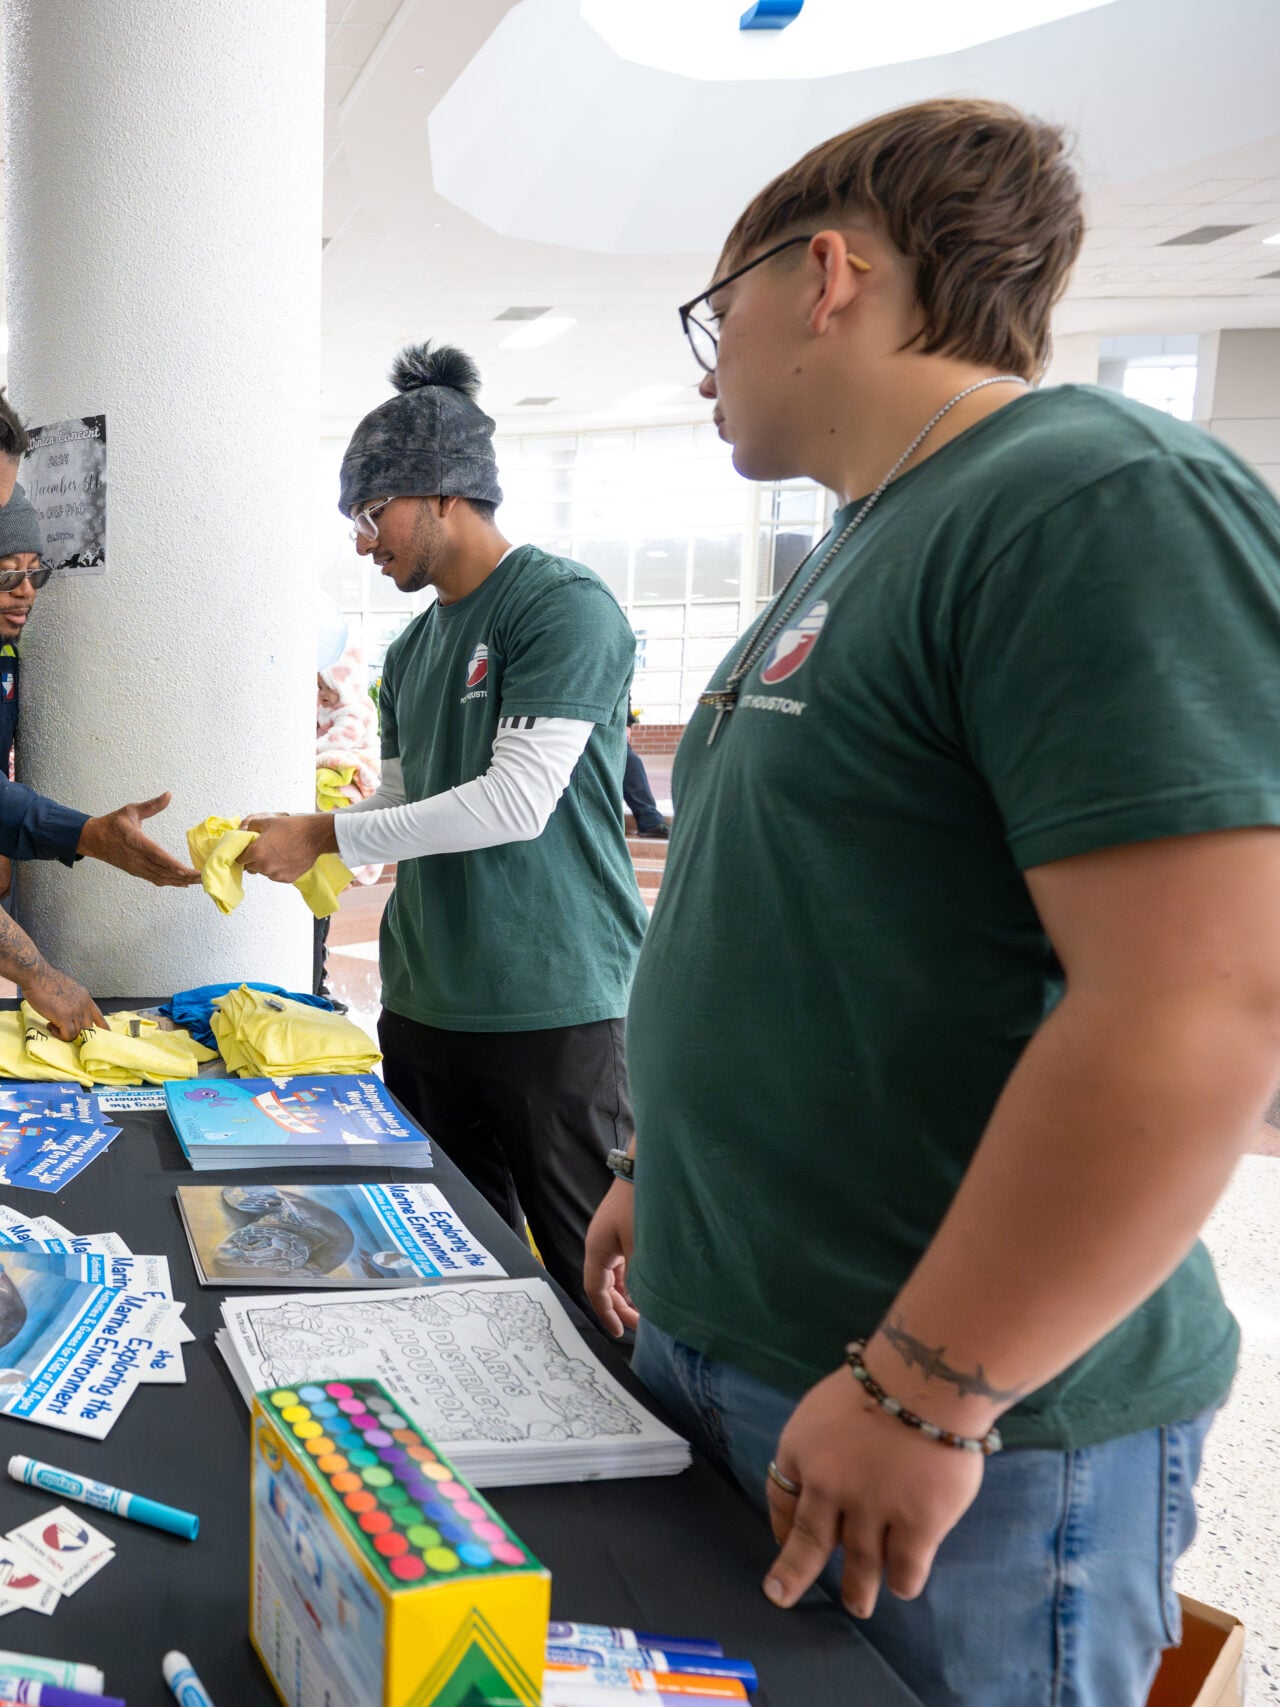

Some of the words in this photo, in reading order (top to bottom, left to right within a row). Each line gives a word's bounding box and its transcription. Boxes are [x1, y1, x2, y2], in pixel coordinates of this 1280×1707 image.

[58, 427, 101, 445] Concert
[30, 475, 79, 500] December
[751, 695, 805, 716] HOUSTON
[361, 1083, 387, 1112] Shipping
[377, 1111, 401, 1129] Makes
[361, 1117, 390, 1134] Round
[69, 1128, 107, 1156] Shipping
[27, 1157, 60, 1177] Round
[51, 1150, 84, 1175] Makes
[387, 1184, 416, 1214] Marine
[407, 1216, 464, 1270] Environment
[429, 1211, 473, 1253] Exploring
[464, 1253, 488, 1267] the
[384, 1210, 402, 1229] Games
[401, 1234, 415, 1248] Kids
[419, 1259, 434, 1274] Ages
[91, 1256, 102, 1283] Activities
[112, 1257, 133, 1292] Marin
[88, 1290, 115, 1320] Activities
[102, 1295, 147, 1335] Marine
[83, 1316, 96, 1327] &
[67, 1324, 91, 1349] Games
[47, 1355, 69, 1375] Kids
[59, 1346, 75, 1359] for
[150, 1350, 174, 1370] the
[40, 1373, 55, 1384] of
[46, 1336, 119, 1415] Environment
[89, 1337, 153, 1398] Exploring
[390, 1329, 476, 1424] HOUSTON
[427, 1330, 510, 1417] DISTRICT
[471, 1346, 531, 1398] ARTS
[32, 1381, 50, 1395] All
[17, 1391, 41, 1412] Ages
[80, 1396, 113, 1420] the
